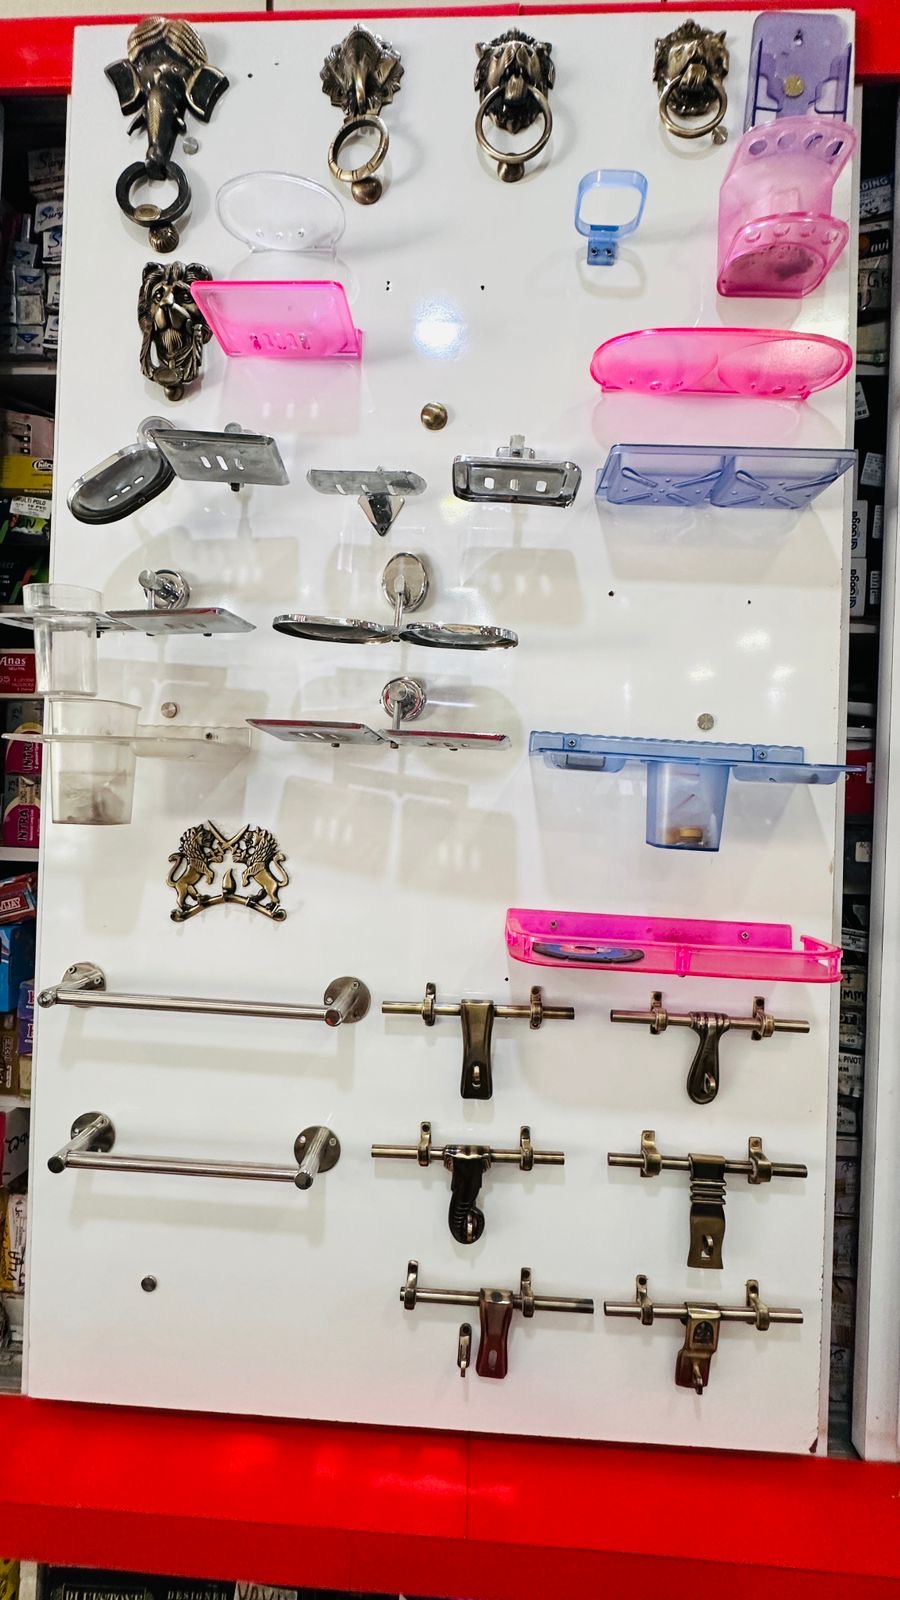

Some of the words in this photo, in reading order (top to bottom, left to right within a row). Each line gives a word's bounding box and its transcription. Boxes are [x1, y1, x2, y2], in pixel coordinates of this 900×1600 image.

[861, 176, 888, 192] DING
[0, 656, 26, 666] Anas
[17, 809, 29, 842] INTRA
